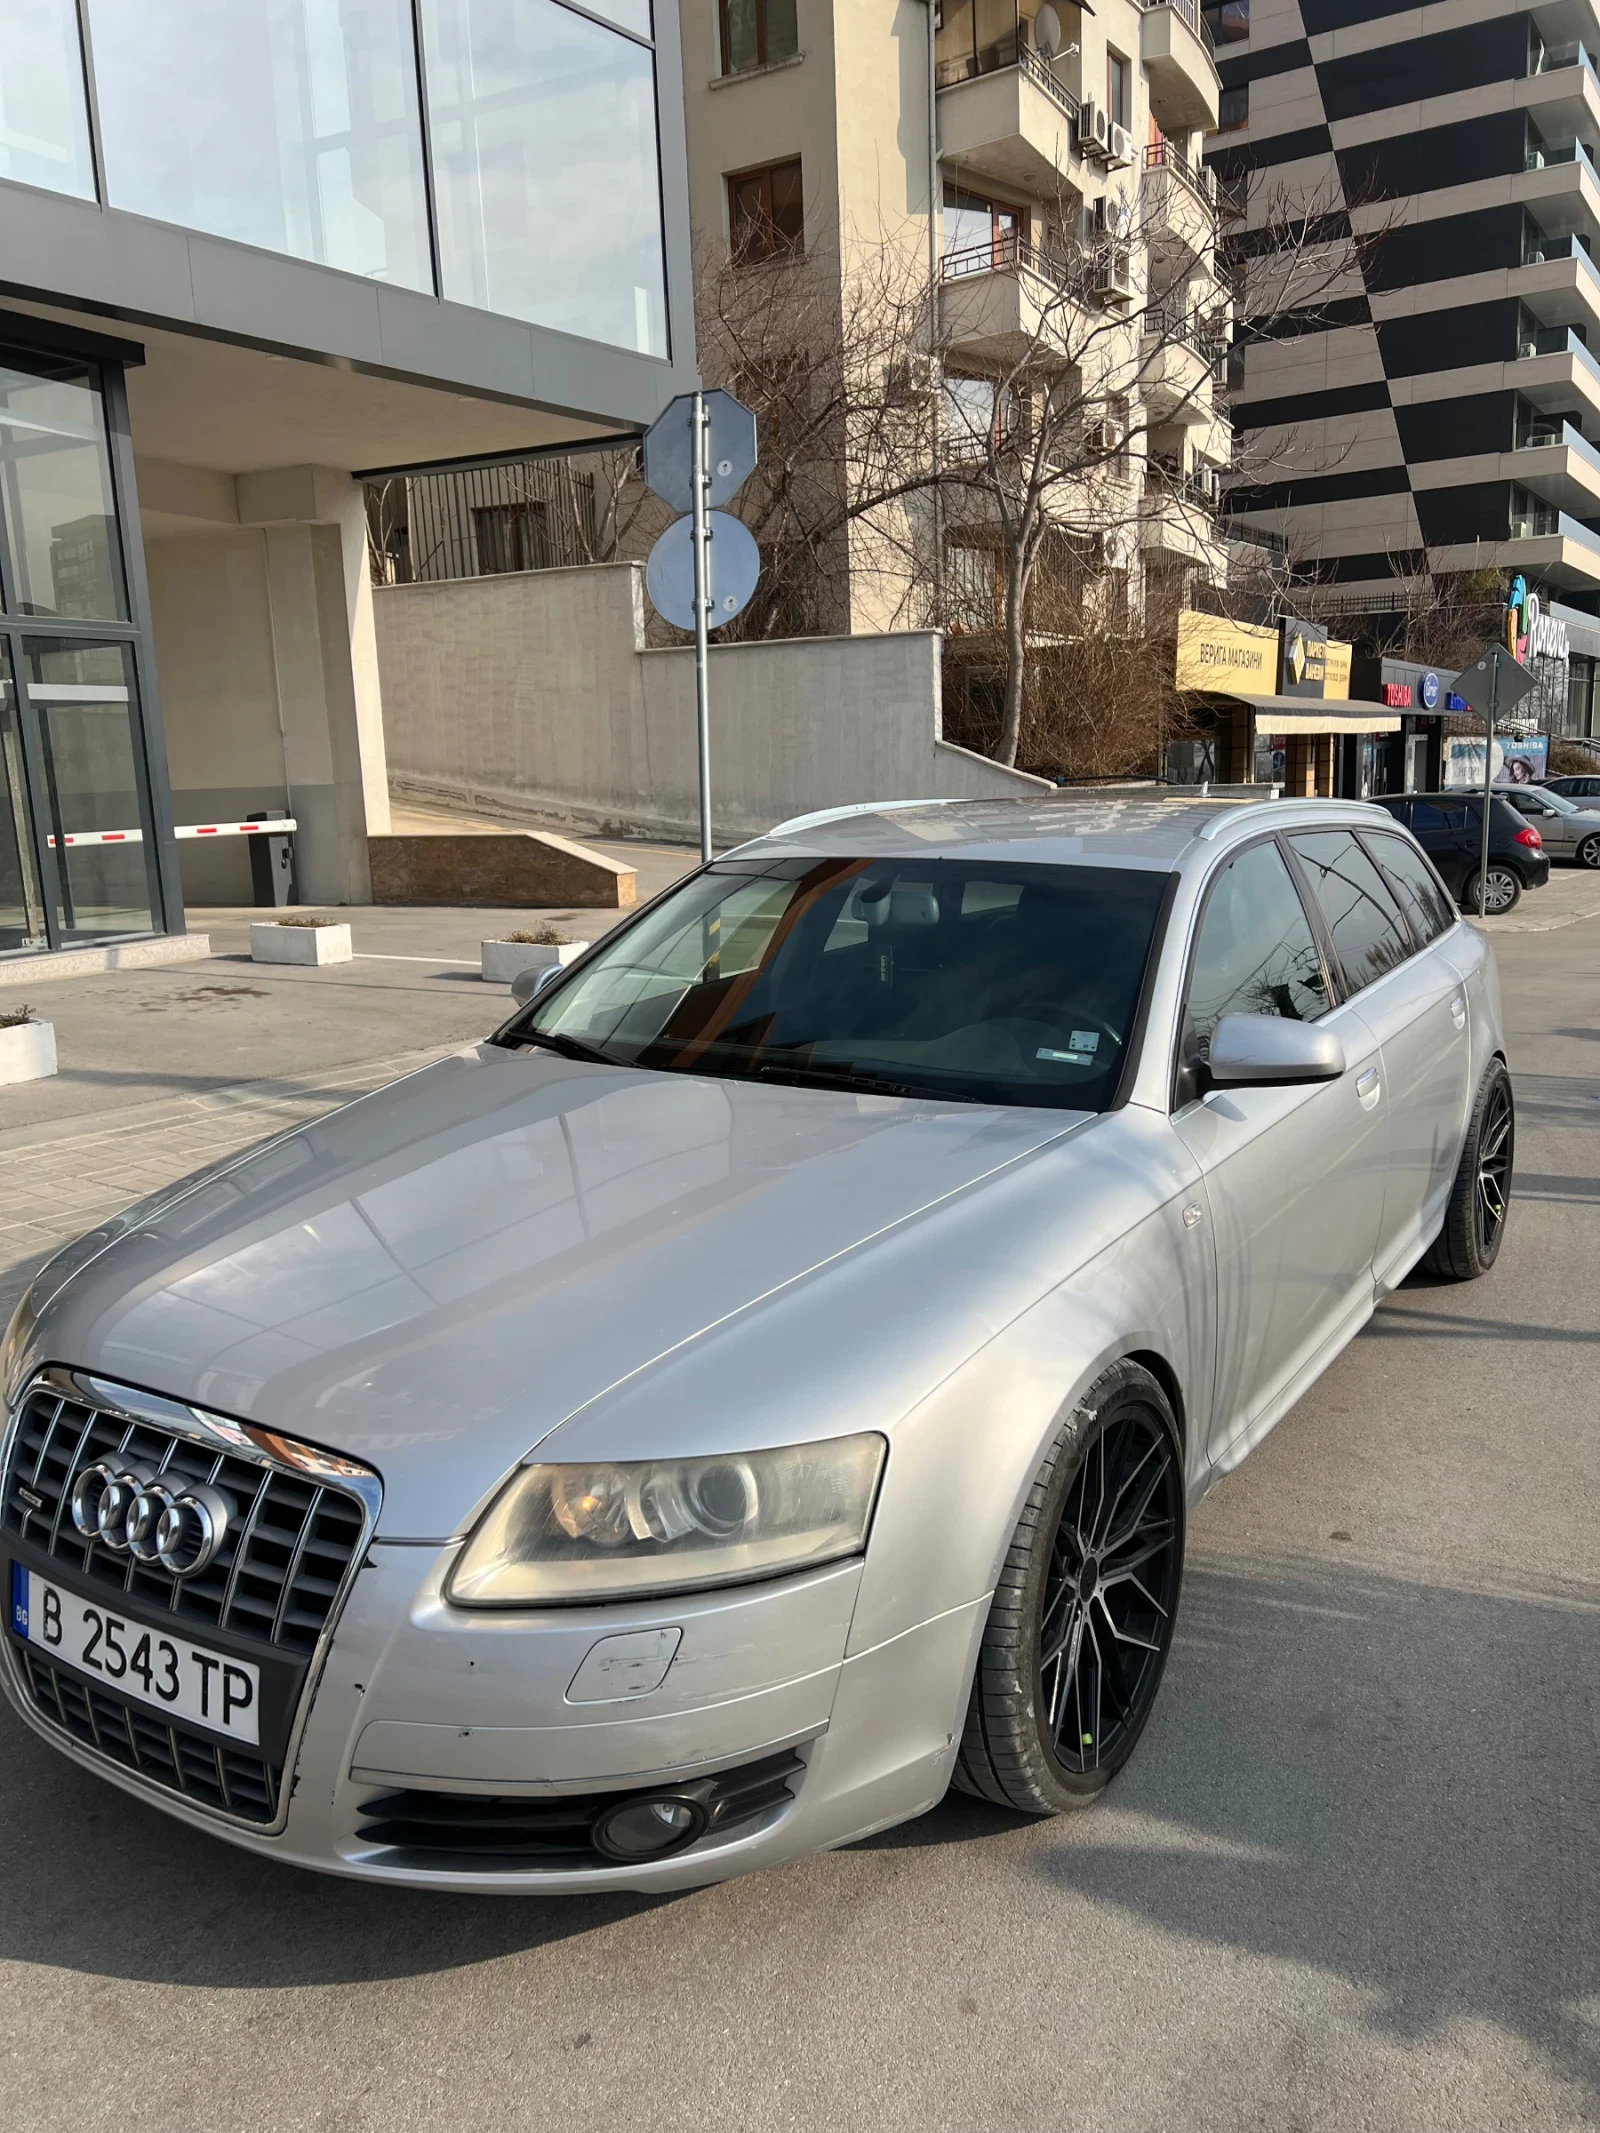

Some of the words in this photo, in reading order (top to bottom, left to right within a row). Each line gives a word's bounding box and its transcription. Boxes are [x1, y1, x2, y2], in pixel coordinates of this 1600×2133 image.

[1200, 643, 1227, 666] ВЕРИГА
[1228, 647, 1263, 671] МАГАЗИНИ
[1386, 683, 1411, 707] TOSHIBA
[1507, 741, 1543, 749] TOSHIBA
[16, 1604, 28, 1625] BG
[43, 1585, 63, 1646] B
[82, 1608, 180, 1702] 2543
[191, 1651, 253, 1725] TP
